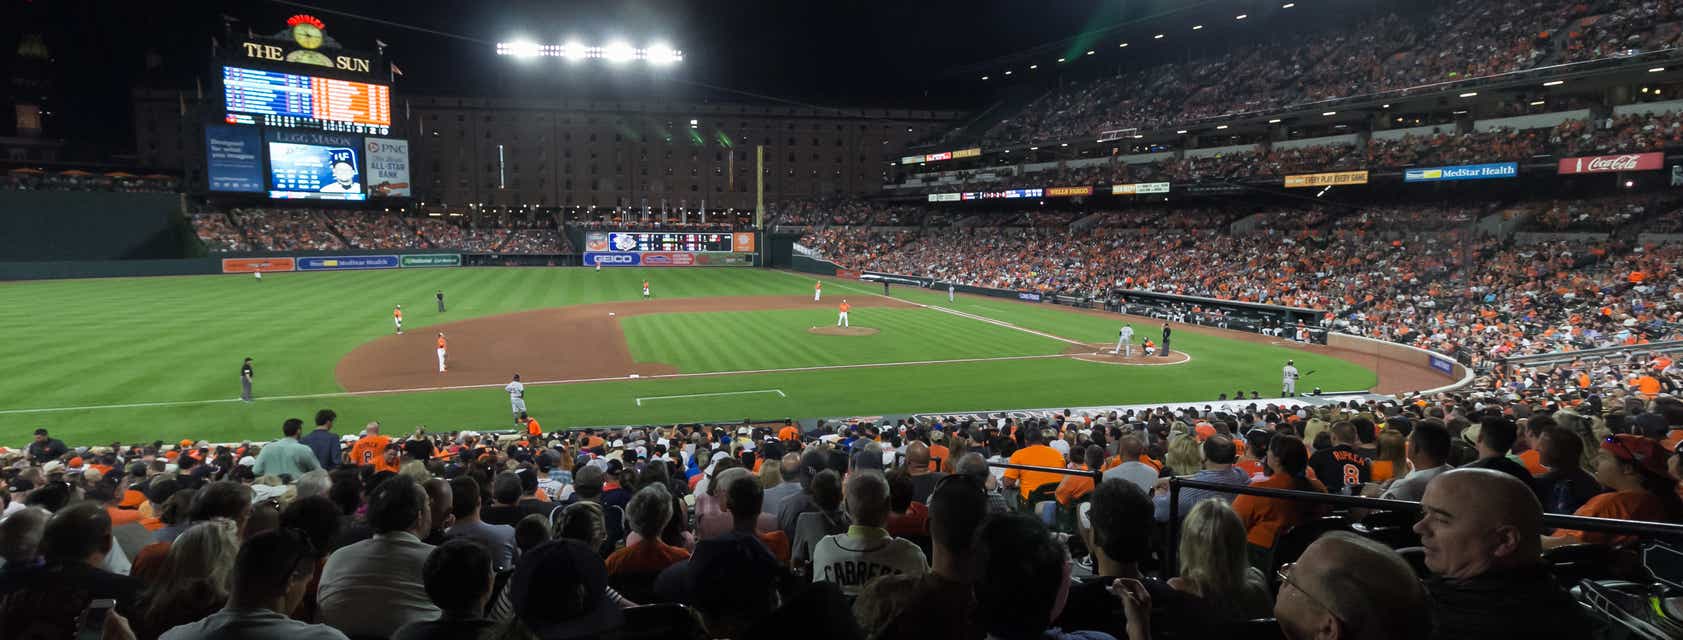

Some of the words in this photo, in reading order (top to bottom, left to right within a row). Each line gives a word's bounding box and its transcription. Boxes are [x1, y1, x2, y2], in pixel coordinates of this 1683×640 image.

[243, 42, 284, 61] THE
[336, 55, 370, 73] SUN
[381, 143, 407, 153] PNC
[1321, 175, 1333, 183] PLAY
[1442, 168, 1480, 178] MedStar
[1481, 166, 1515, 176] Health
[593, 255, 633, 263] GEICO
[1333, 450, 1365, 466] RIPKEN
[1343, 463, 1359, 486] 8
[824, 560, 903, 586] CABRE
